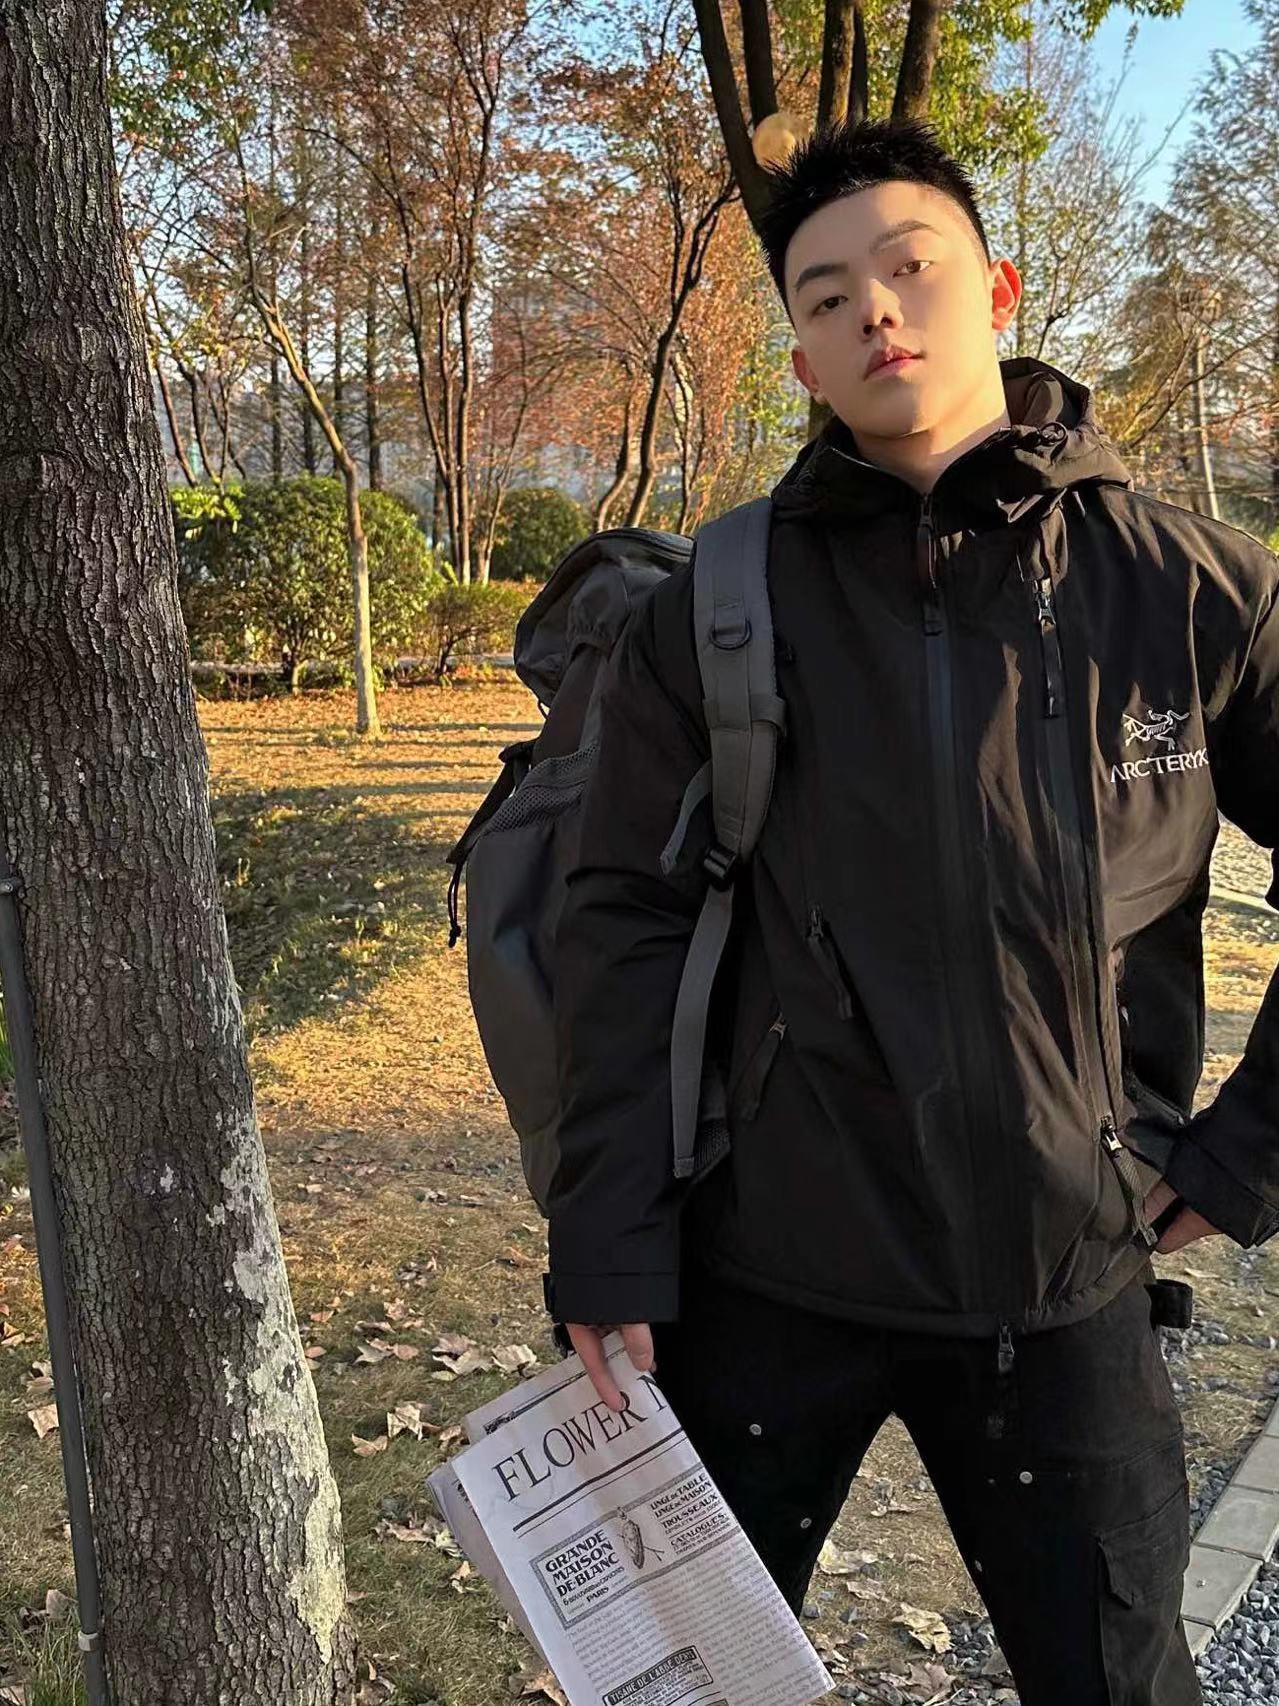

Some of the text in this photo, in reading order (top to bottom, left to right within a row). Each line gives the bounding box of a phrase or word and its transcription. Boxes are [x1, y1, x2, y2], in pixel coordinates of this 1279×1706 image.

[491, 1390, 648, 1502] FLOWER
[677, 1473, 708, 1495] TABLE
[680, 1481, 712, 1502] MAISON
[662, 1492, 718, 1528] TROUSSEAUX
[545, 1529, 607, 1572] GRANDE
[552, 1541, 613, 1585] MAISON
[575, 1552, 619, 1586] BLANC
[610, 1682, 638, 1702] TISANE
[636, 1676, 649, 1687] DE
